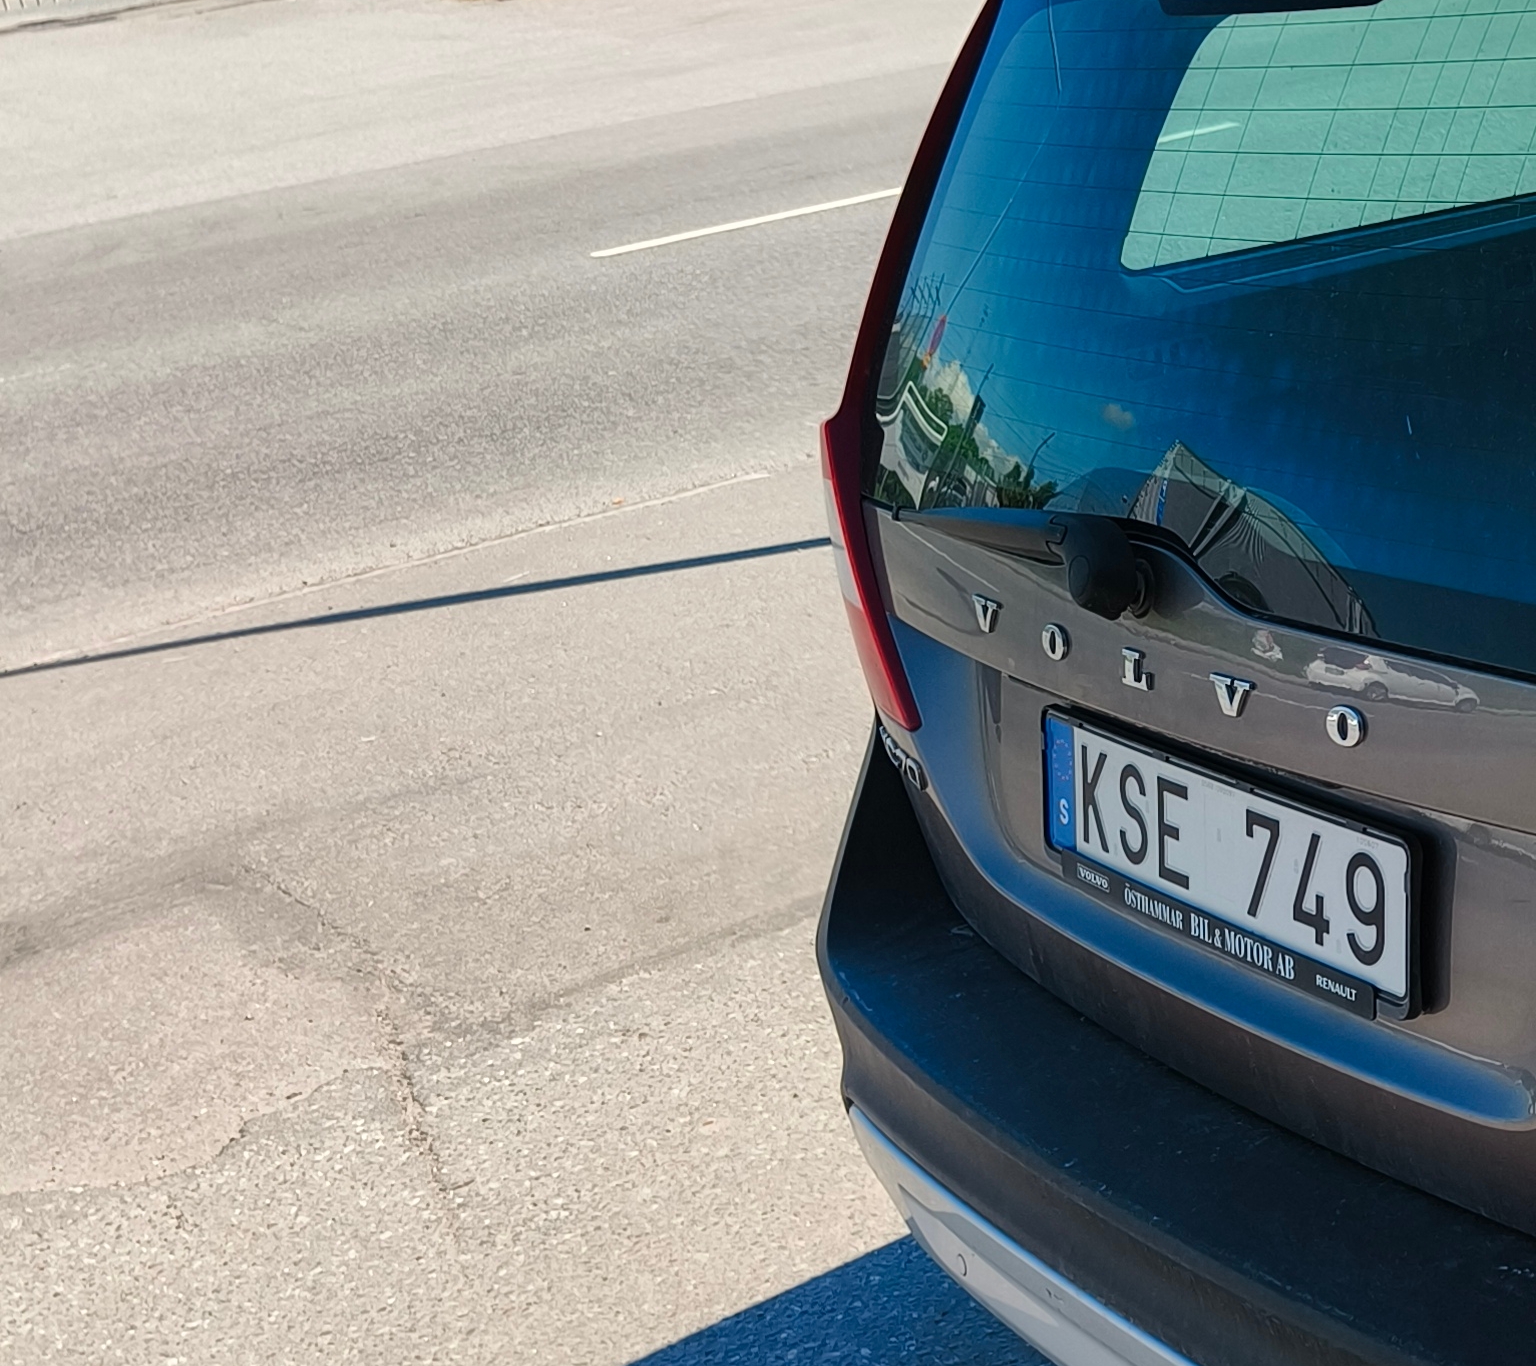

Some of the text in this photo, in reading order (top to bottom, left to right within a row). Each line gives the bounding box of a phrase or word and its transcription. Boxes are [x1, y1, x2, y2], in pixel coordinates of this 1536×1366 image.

[971, 593, 1367, 748] VOLVO
[1059, 798, 1069, 825] S
[1079, 866, 1109, 889] VOLVO
[1082, 744, 1386, 967] KSE 749
[1124, 882, 1296, 981] ÖSTHAMMAR BIL & MOTOR AB
[1315, 974, 1357, 1002] RENAULT
